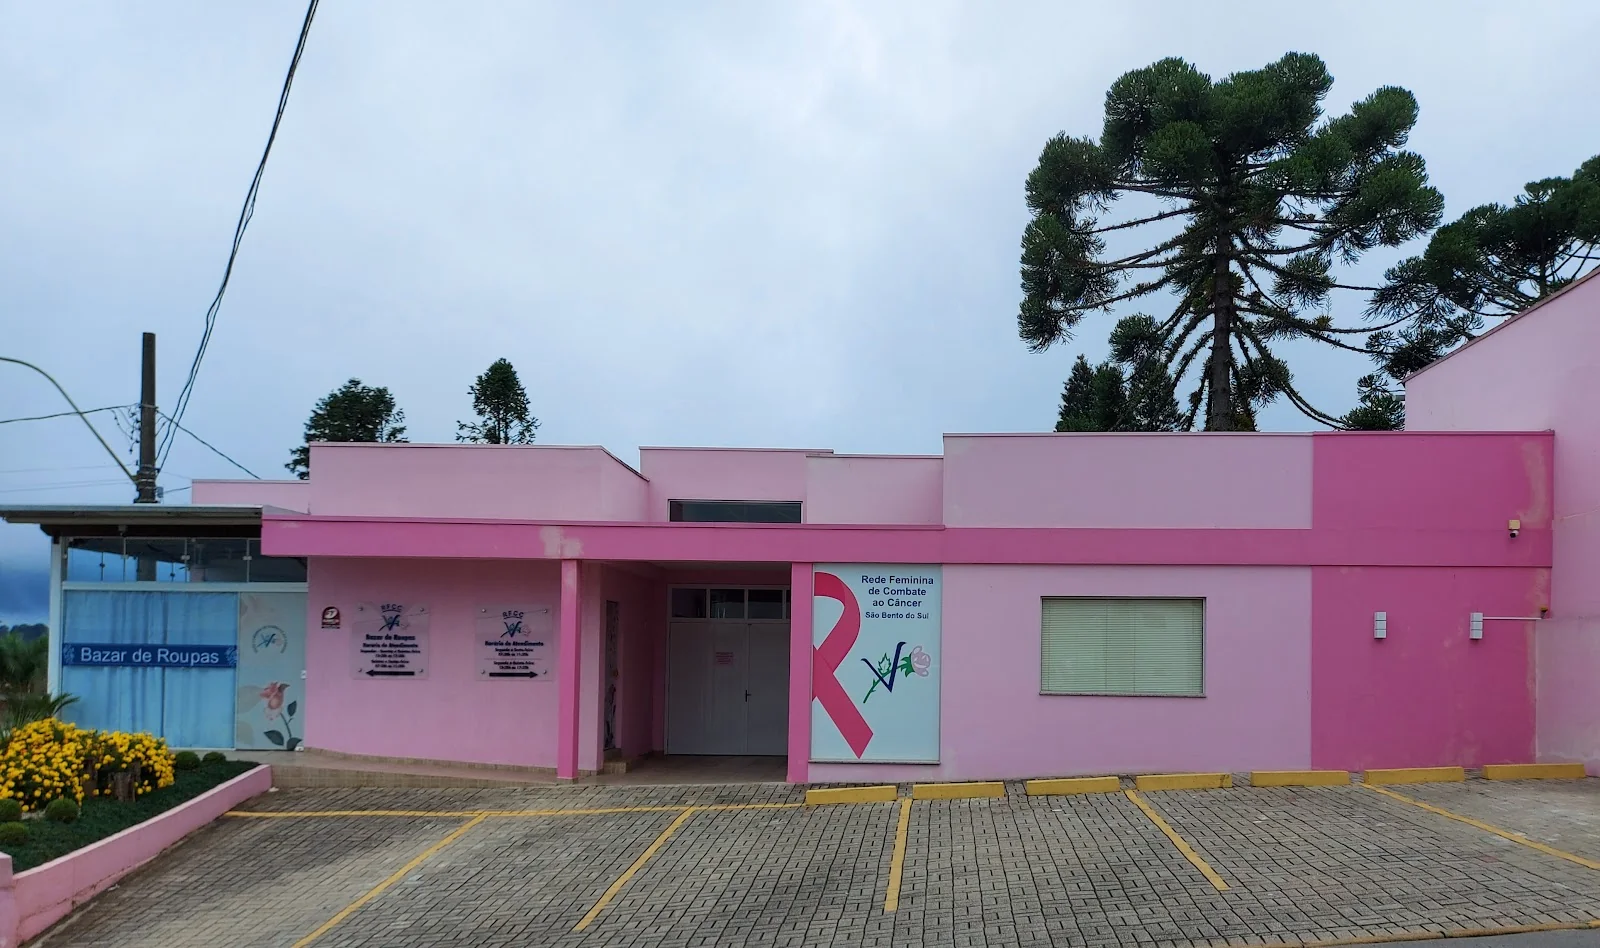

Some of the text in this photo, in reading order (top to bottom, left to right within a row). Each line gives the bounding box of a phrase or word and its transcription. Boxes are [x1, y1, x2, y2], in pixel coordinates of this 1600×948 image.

[861, 575, 934, 585] Rede Feminina
[868, 587, 927, 596] de Combate
[887, 598, 922, 607] Câncer
[865, 611, 880, 619] São
[80, 647, 219, 666] Bazar de Roupas
